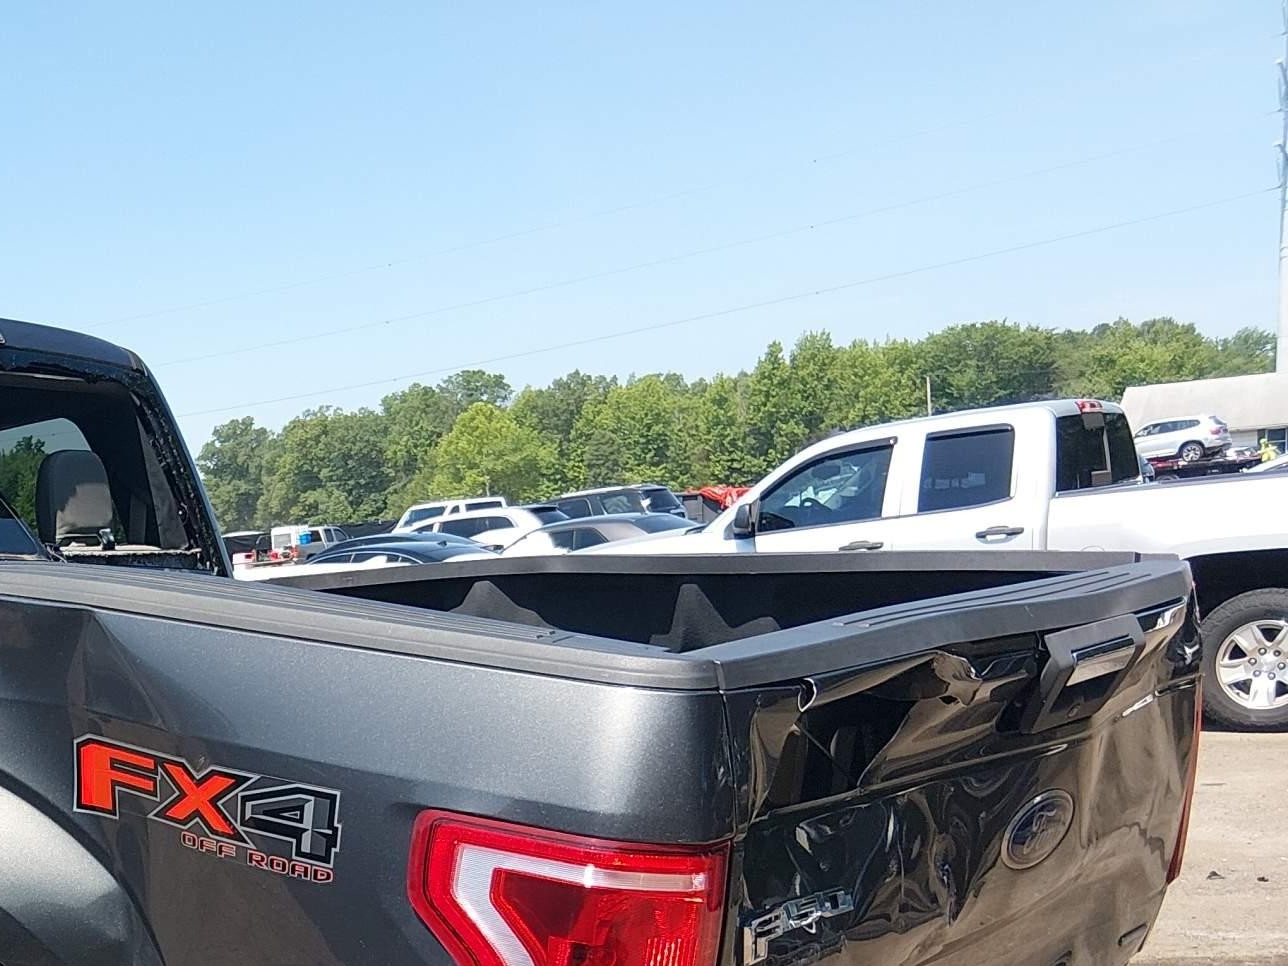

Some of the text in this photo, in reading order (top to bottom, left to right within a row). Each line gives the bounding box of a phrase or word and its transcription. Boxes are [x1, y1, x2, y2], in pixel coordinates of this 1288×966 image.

[73, 733, 342, 868] FX4
[180, 831, 334, 884] OFF ROAD
